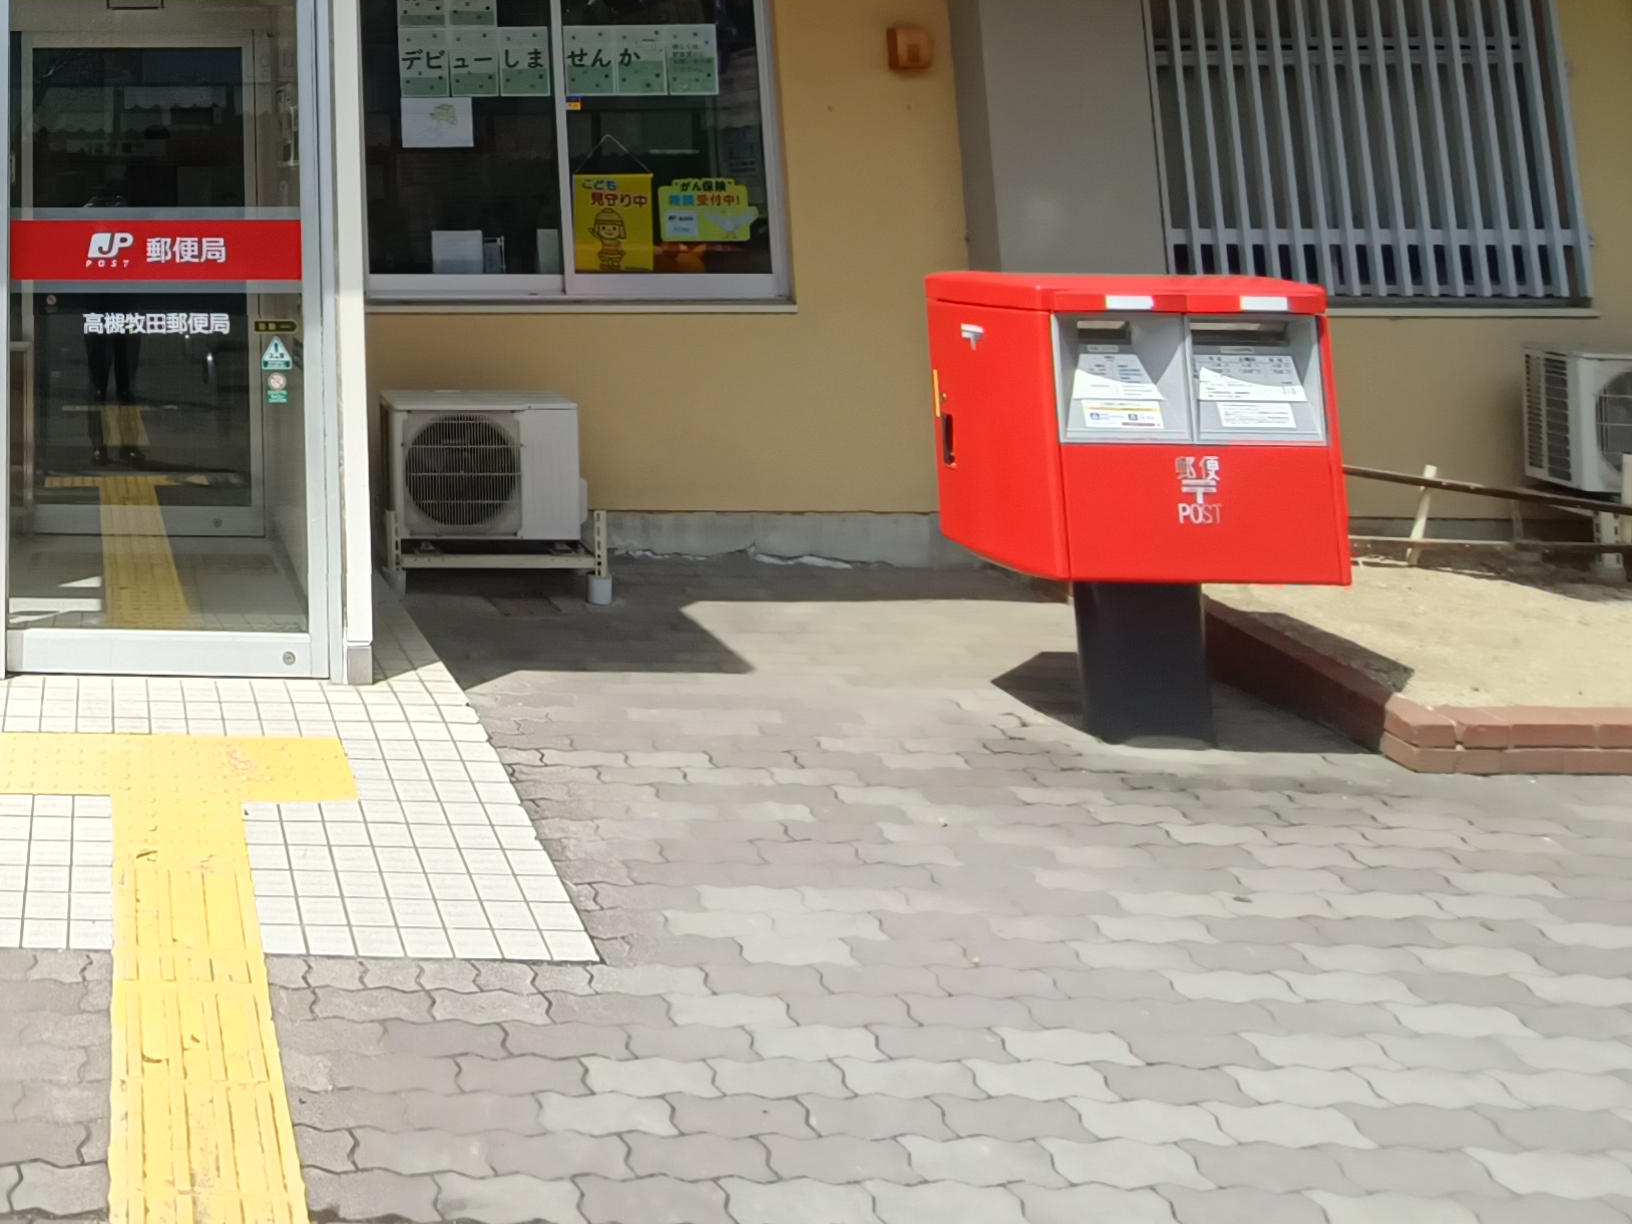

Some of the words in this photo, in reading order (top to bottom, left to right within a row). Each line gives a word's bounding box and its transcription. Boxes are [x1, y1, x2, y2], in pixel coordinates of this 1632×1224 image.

[582, 179, 617, 191] こども
[591, 192, 648, 208] 見守り中
[87, 232, 134, 258] JP
[146, 237, 226, 263] 郵便局
[85, 259, 130, 268] POST
[83, 312, 230, 335] 高槻牧田郵便局
[1175, 456, 1221, 481] 郵便
[1178, 503, 1222, 524] POST
